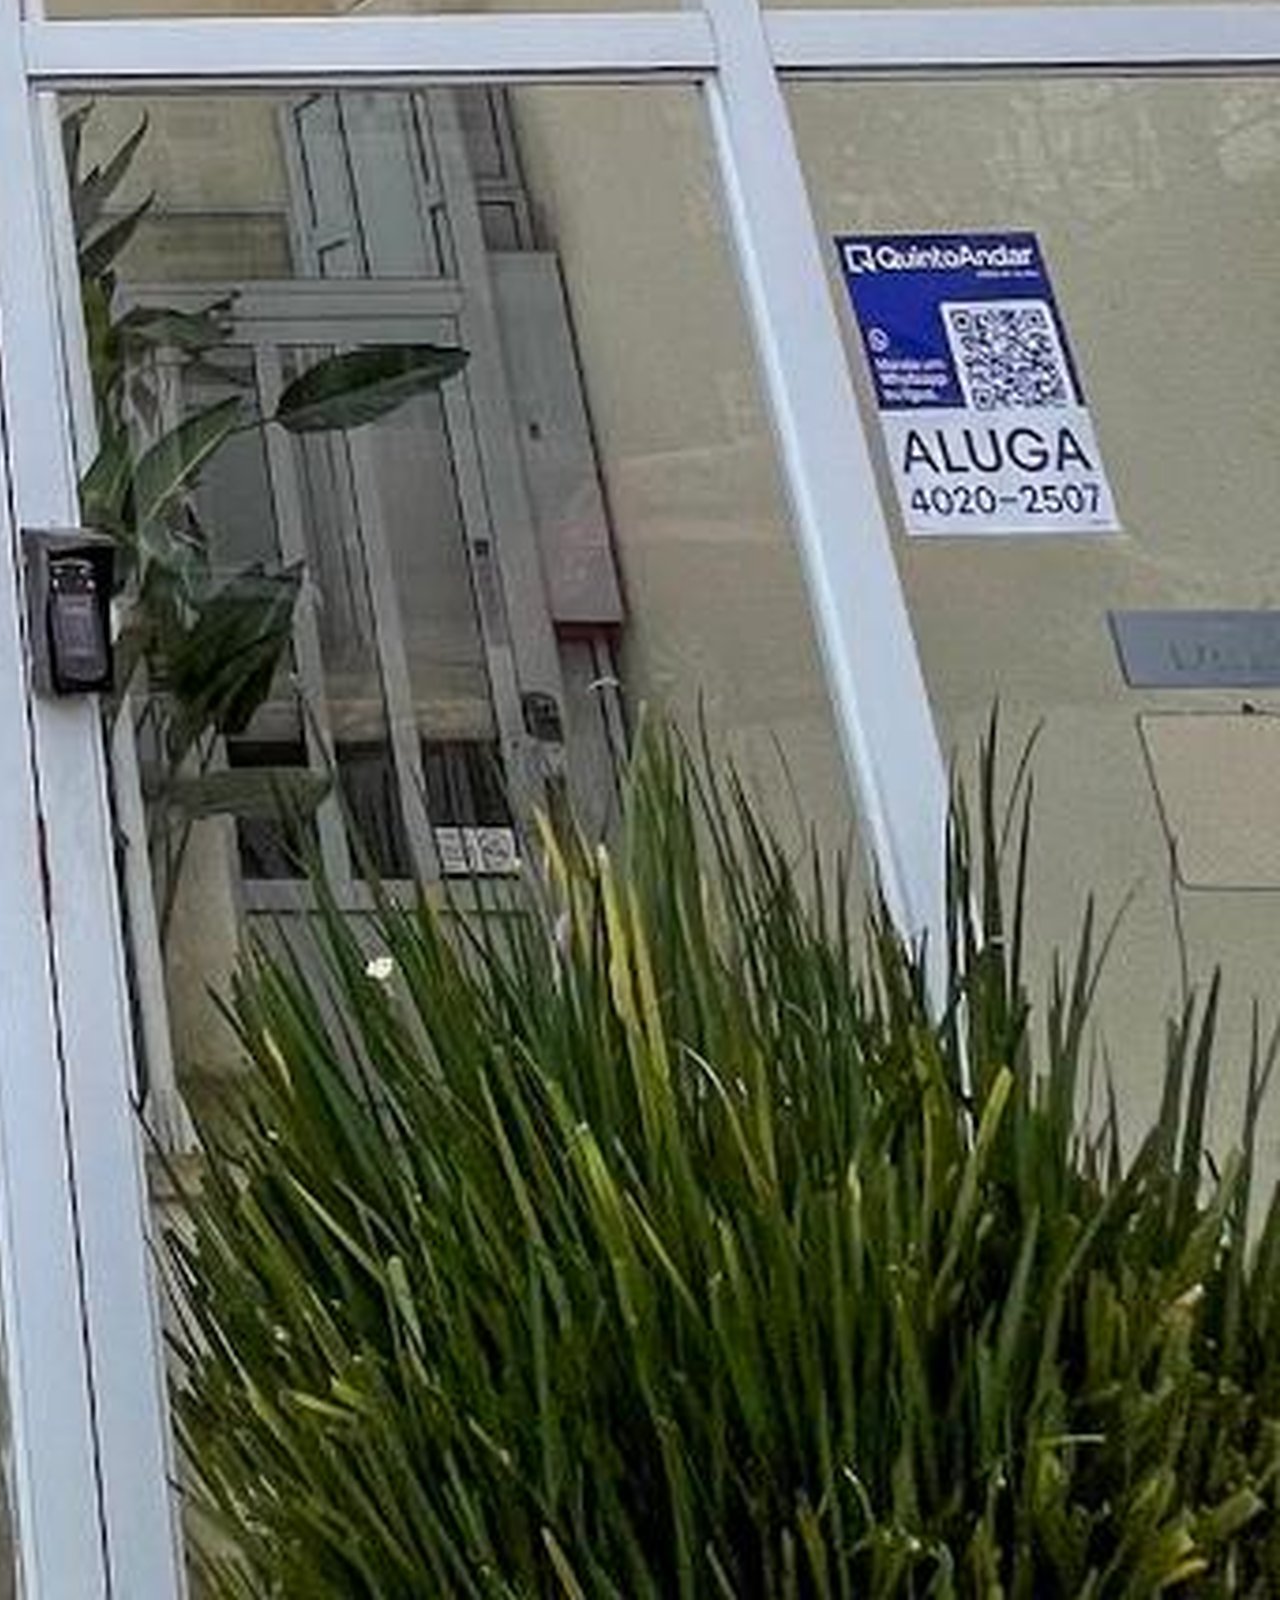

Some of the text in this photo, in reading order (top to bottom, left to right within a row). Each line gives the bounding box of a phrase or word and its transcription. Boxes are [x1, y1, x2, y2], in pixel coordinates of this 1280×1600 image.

[875, 244, 1034, 270] QuintoAndar
[903, 428, 1093, 474] ALUGA
[910, 484, 1101, 515] 4020-2507
